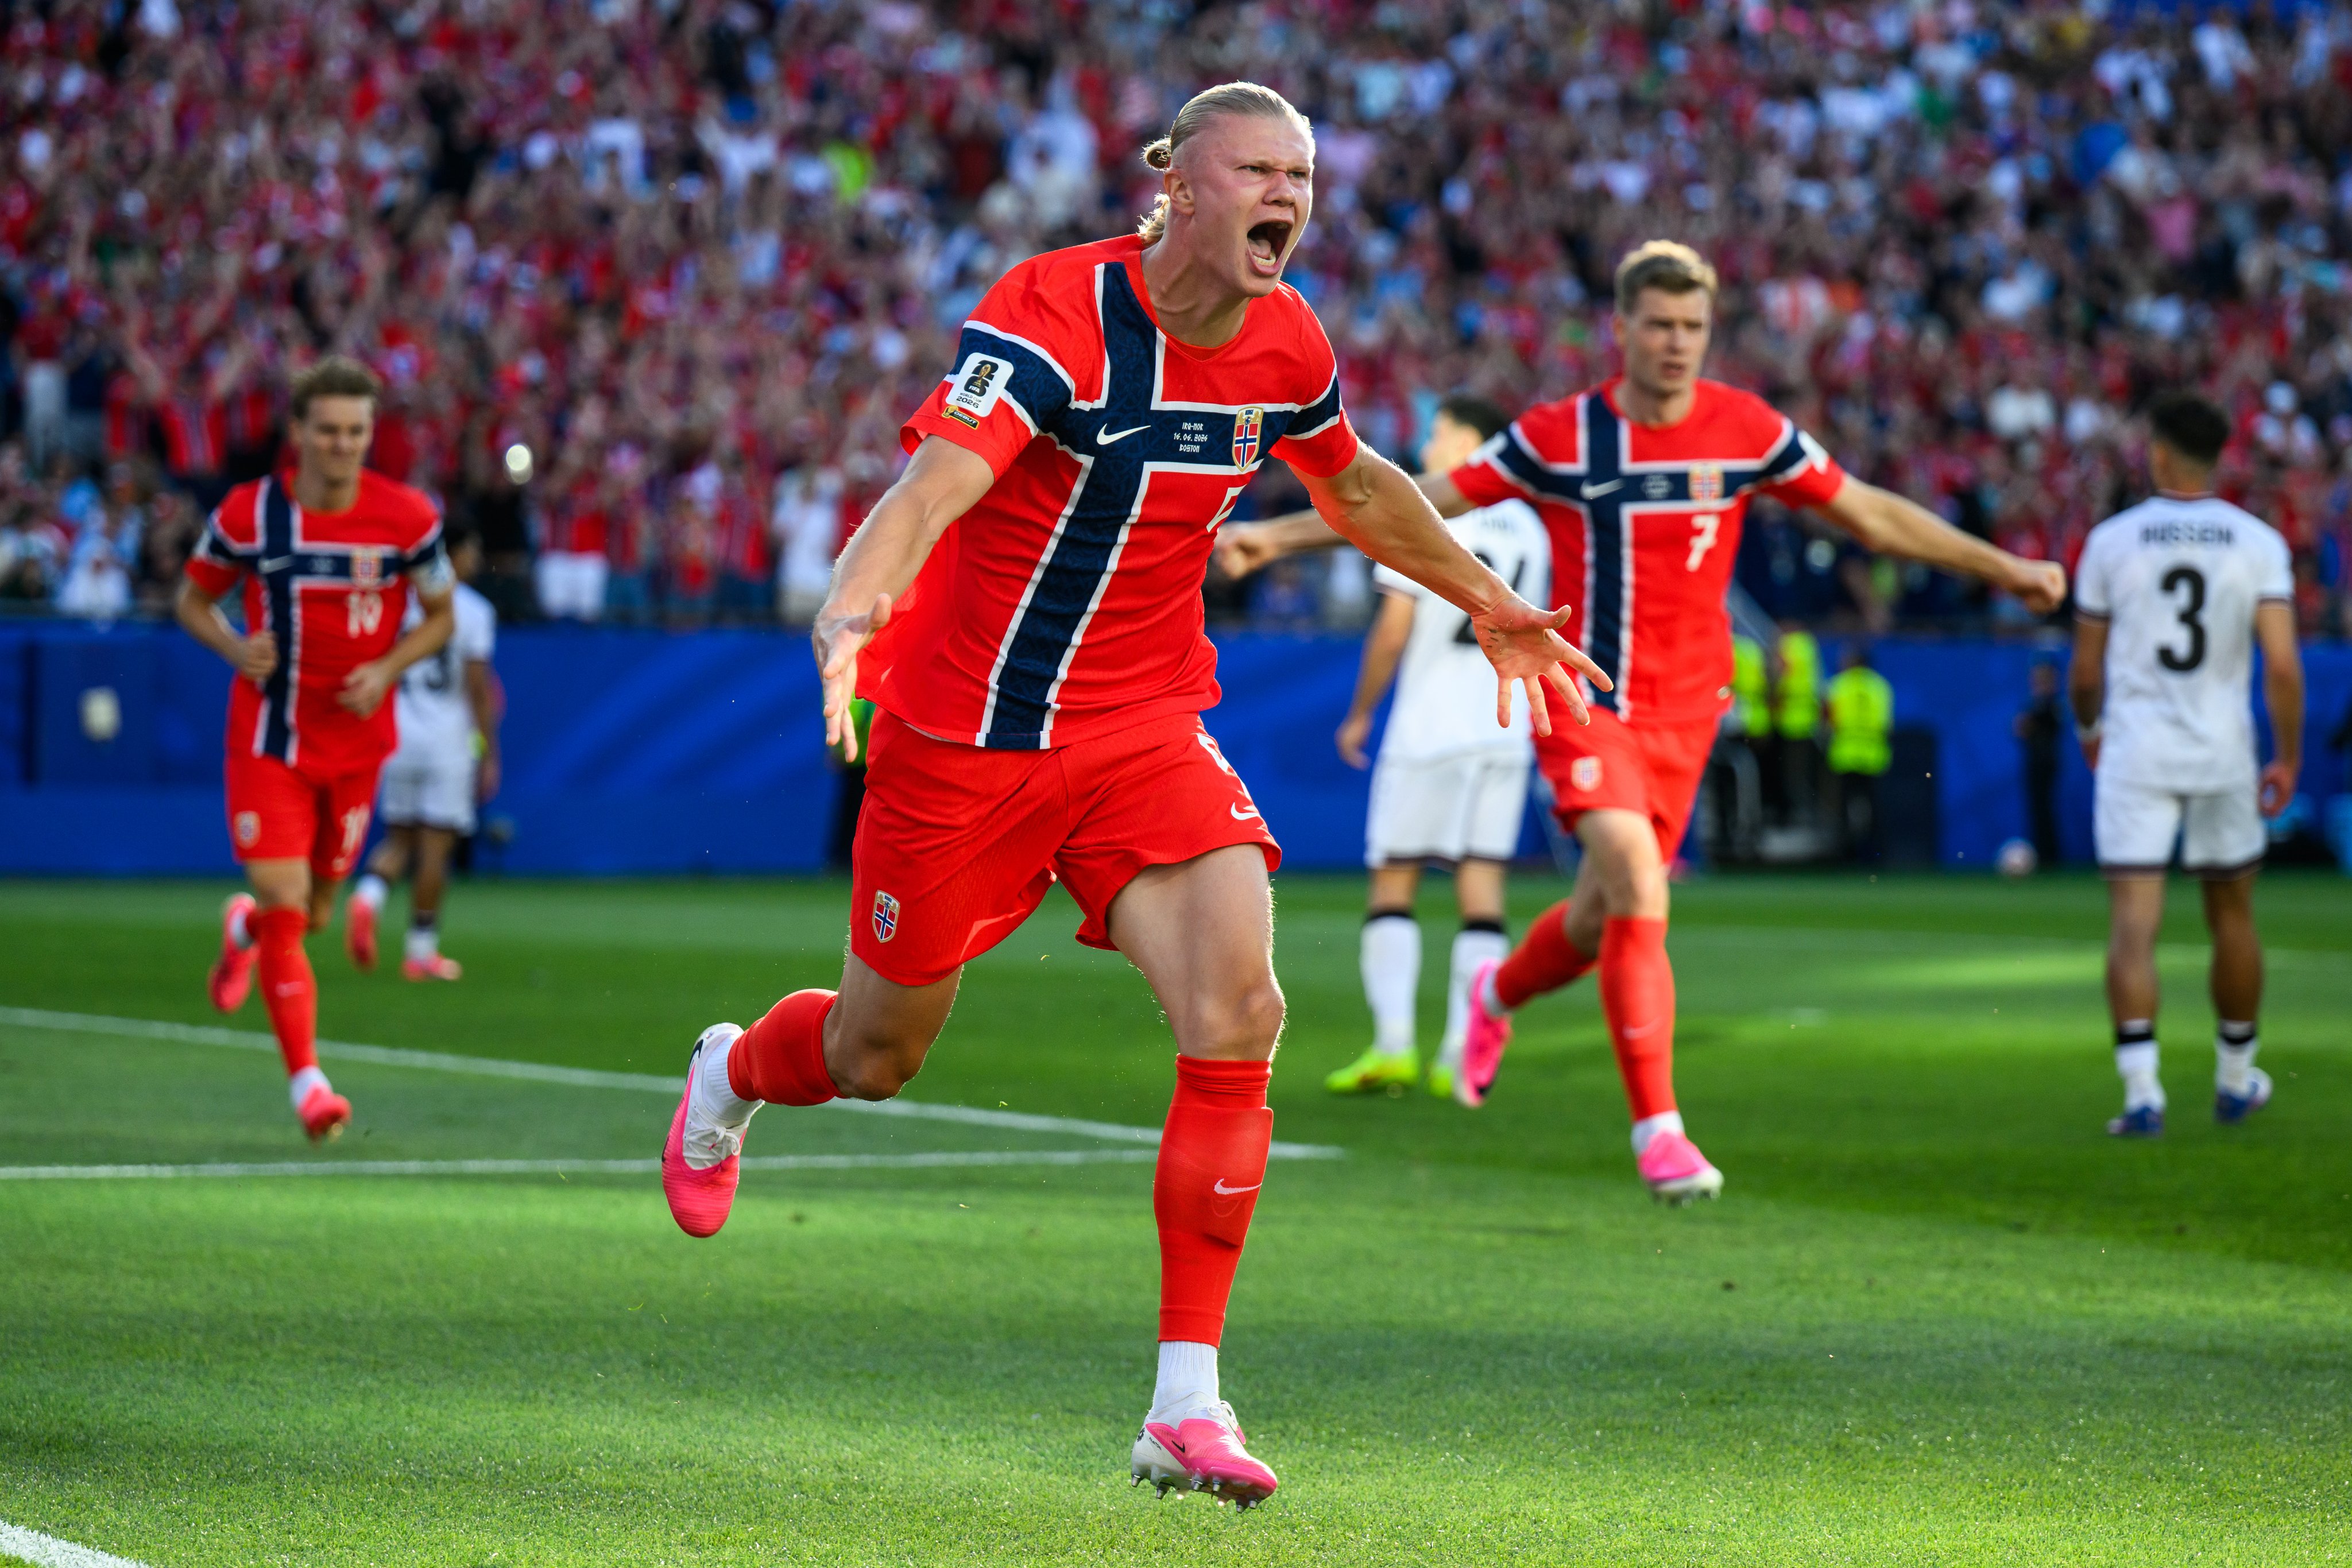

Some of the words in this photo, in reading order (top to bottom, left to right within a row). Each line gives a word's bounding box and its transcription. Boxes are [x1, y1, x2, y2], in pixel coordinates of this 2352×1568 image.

[968, 385, 980, 393] FIFA
[956, 396, 980, 409] 2026
[953, 411, 977, 424] DEBUT
[1182, 422, 1204, 431] IRQ-NOR
[1179, 444, 1200, 453] BOSTON
[1686, 514, 1720, 572] 7
[345, 592, 384, 638] 10
[2157, 566, 2207, 672] 3
[1148, 1437, 1162, 1450] PHANTOM
